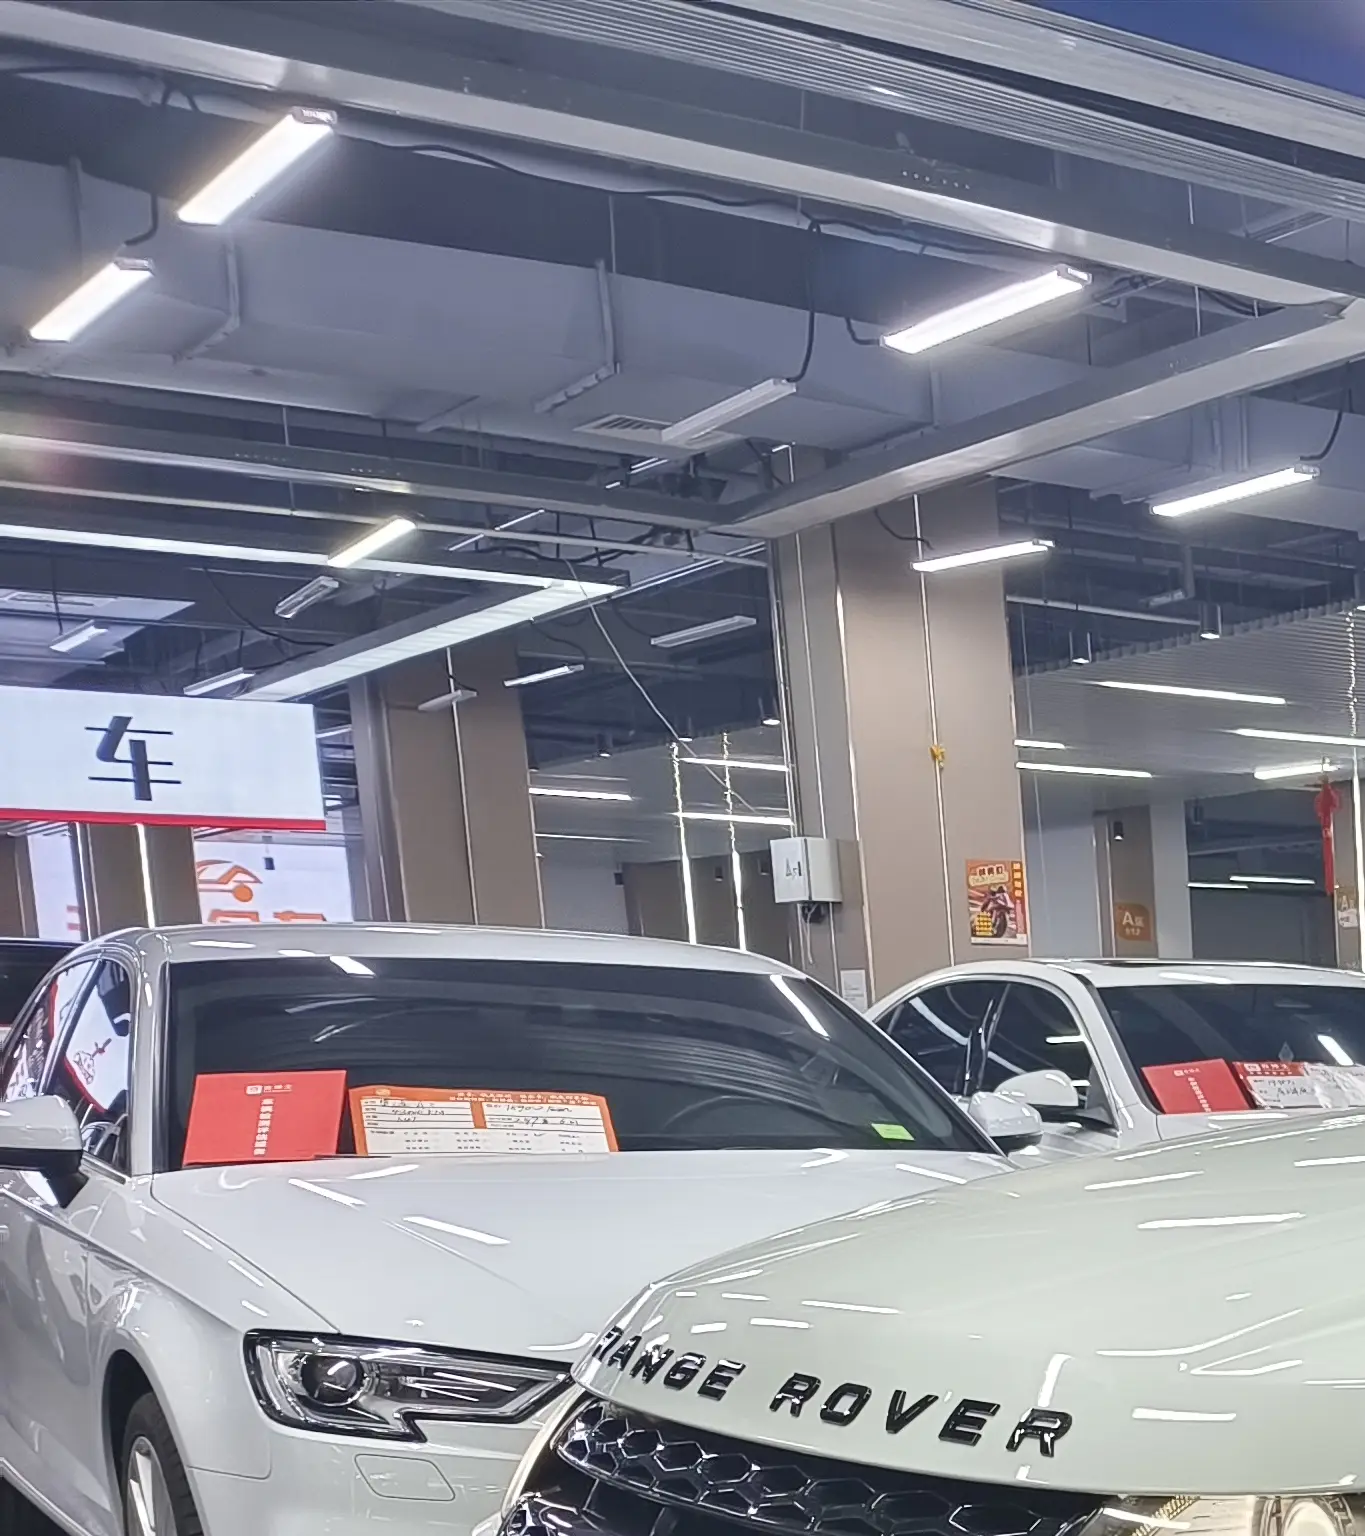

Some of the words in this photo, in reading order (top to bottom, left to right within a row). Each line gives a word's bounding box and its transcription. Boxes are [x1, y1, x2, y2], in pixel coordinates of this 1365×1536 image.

[84, 715, 182, 802] 车
[591, 1325, 746, 1400] RANGE
[769, 1372, 1074, 1458] ROVER
